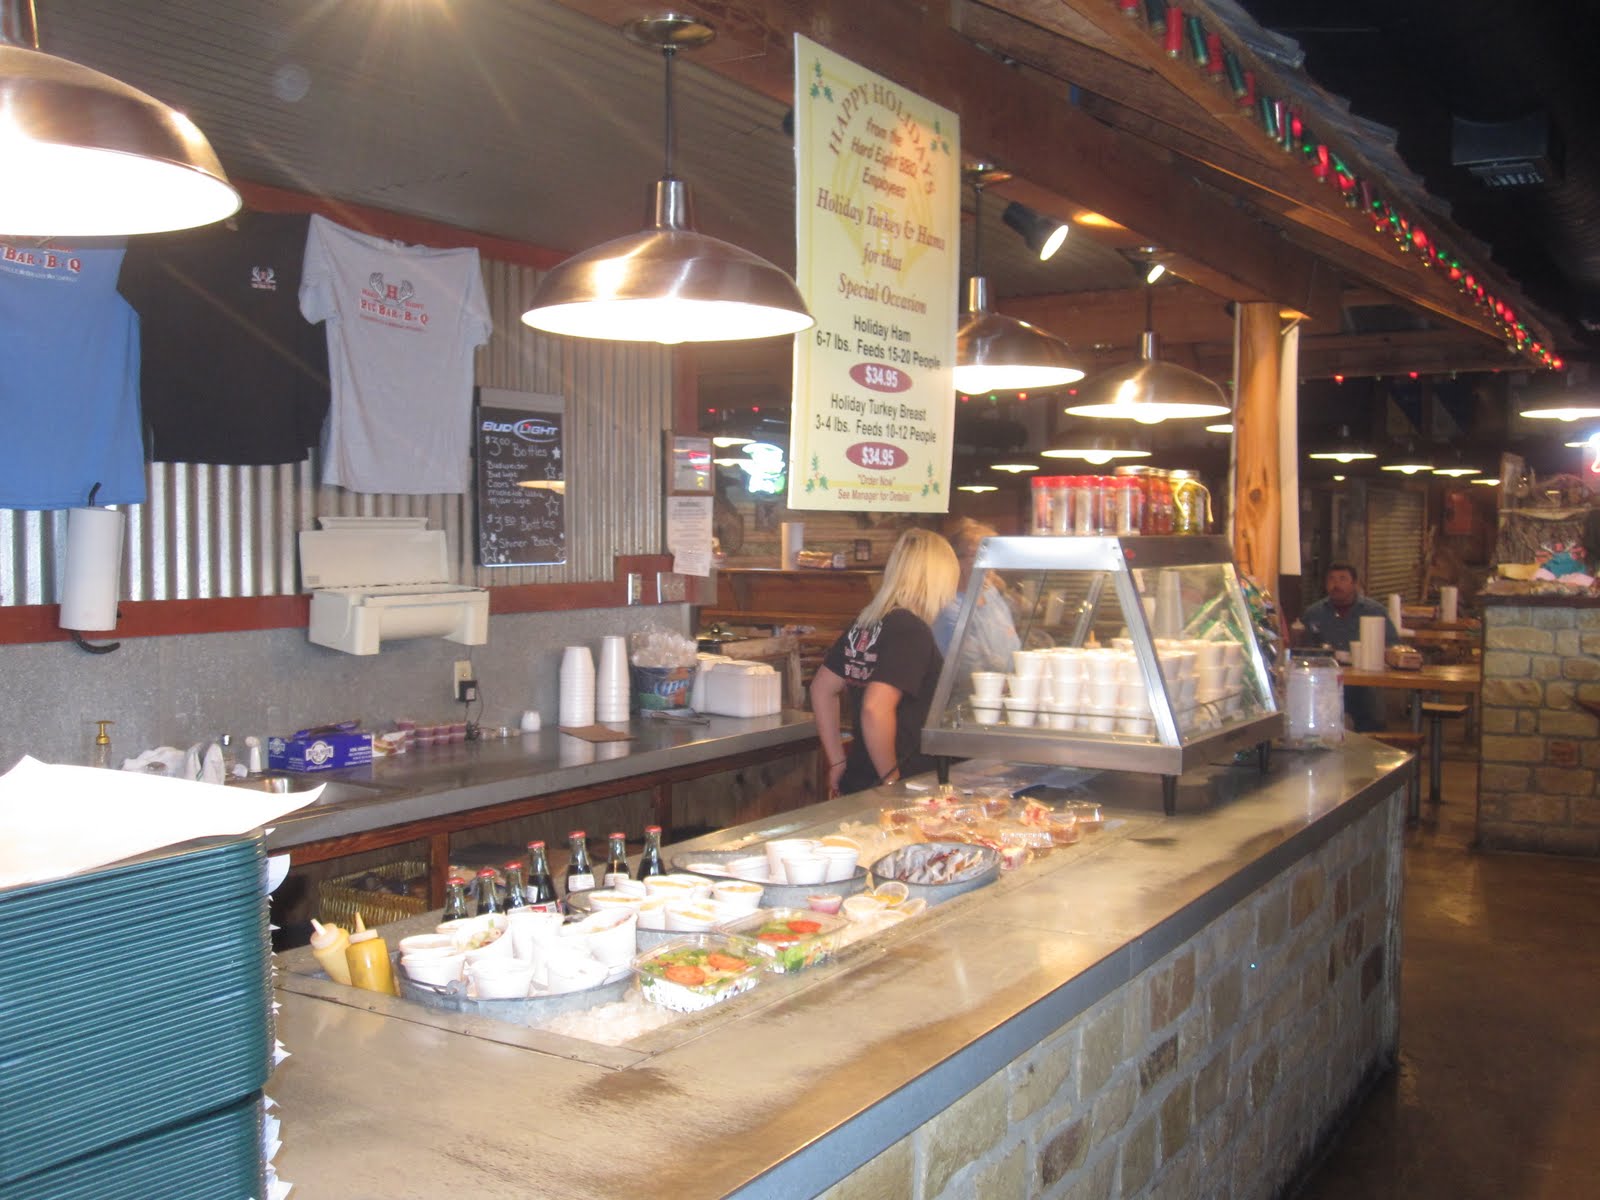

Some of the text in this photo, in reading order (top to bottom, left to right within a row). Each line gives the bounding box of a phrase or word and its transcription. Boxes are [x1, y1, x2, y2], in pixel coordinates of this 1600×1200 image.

[829, 82, 869, 156] HAPPY
[866, 117, 888, 140] from
[851, 136, 874, 159] Hard
[816, 187, 946, 250] Holiday Turkey & Hams
[861, 242, 880, 266] for
[838, 272, 927, 315] Special Occasion
[853, 315, 911, 343] Holiday Ham
[816, 332, 941, 370] 6-7 lbs. Feeds 15-20 People
[865, 365, 898, 389] $34.95
[831, 393, 927, 422] Holiday Turkey Breast
[482, 421, 558, 435] BUD LIGHT
[815, 414, 937, 444] 3-4 lbs. Feeds 10-12 People
[512, 442, 547, 457] Bottles
[862, 444, 894, 467] $34.95
[838, 489, 850, 500] See
